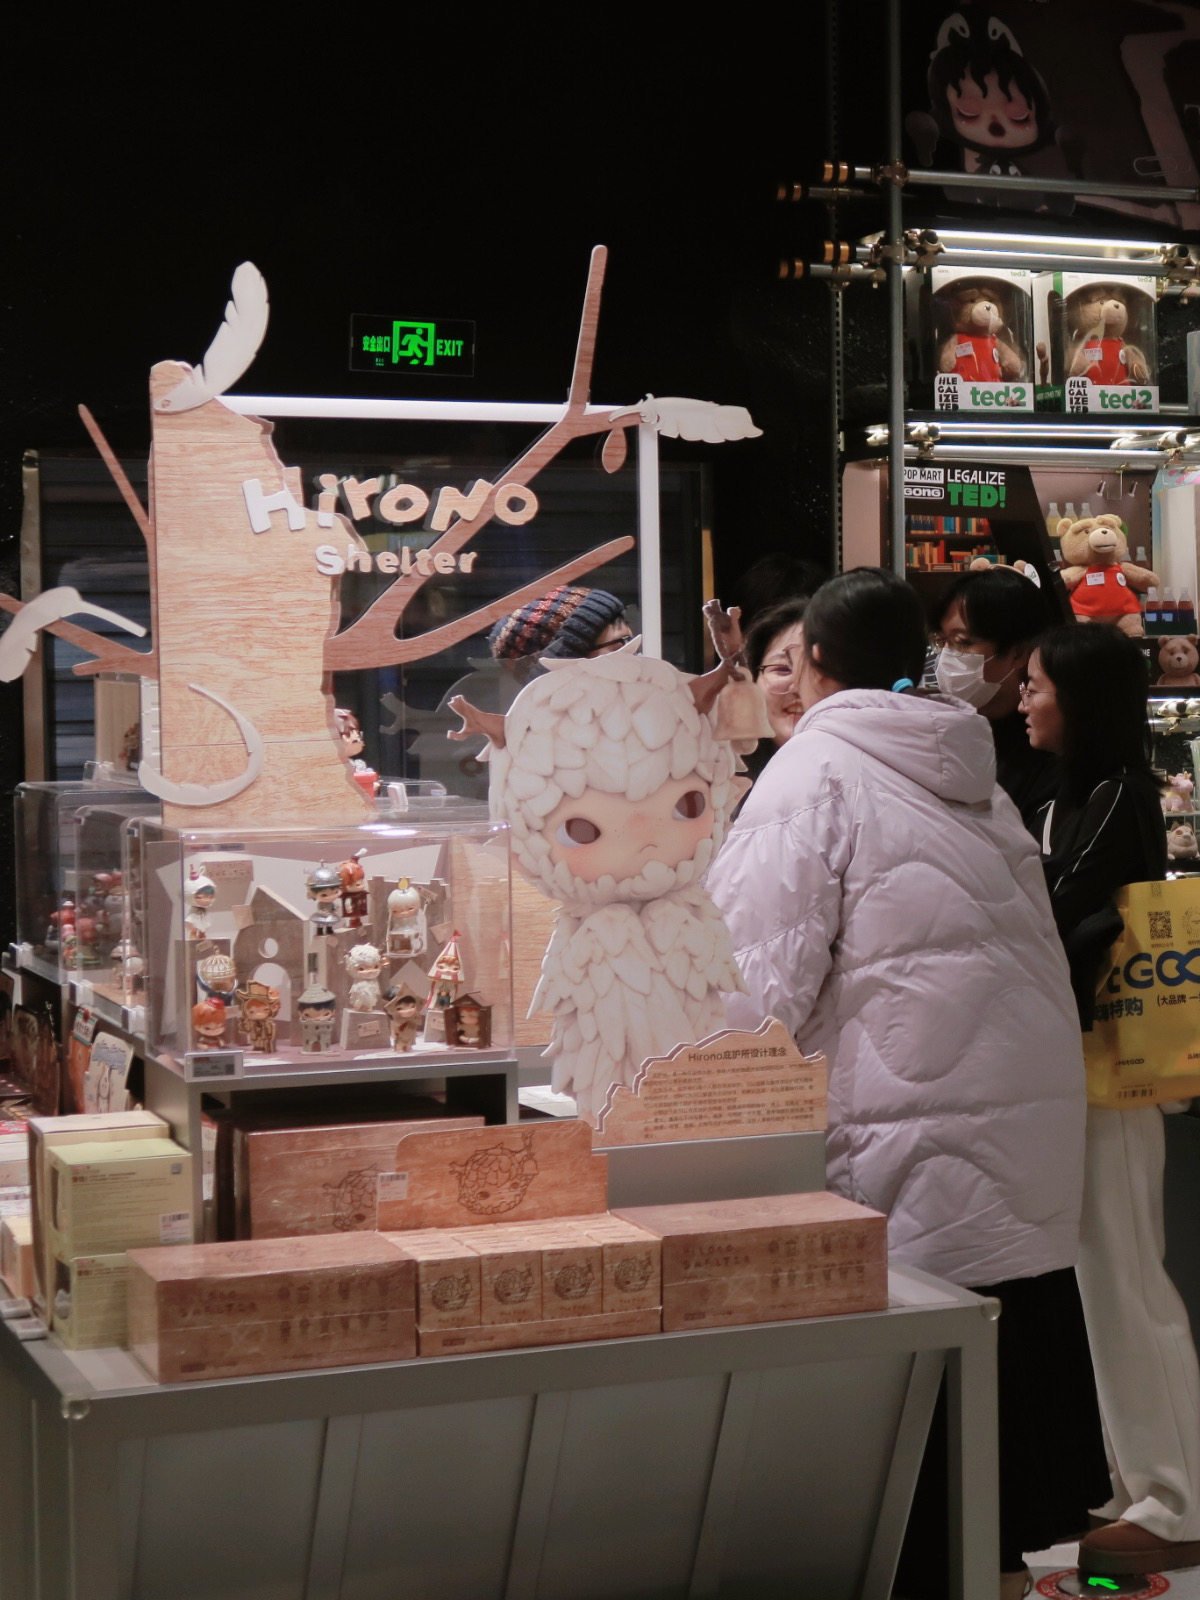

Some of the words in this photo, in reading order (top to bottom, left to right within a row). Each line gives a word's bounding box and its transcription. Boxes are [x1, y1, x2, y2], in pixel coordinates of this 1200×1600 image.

[436, 338, 464, 357] EXIT
[938, 394, 959, 403] IZE
[1069, 397, 1089, 406] IZE
[919, 470, 942, 481] MART
[947, 469, 1006, 485] LEGALIZE
[947, 484, 1006, 508] TED!
